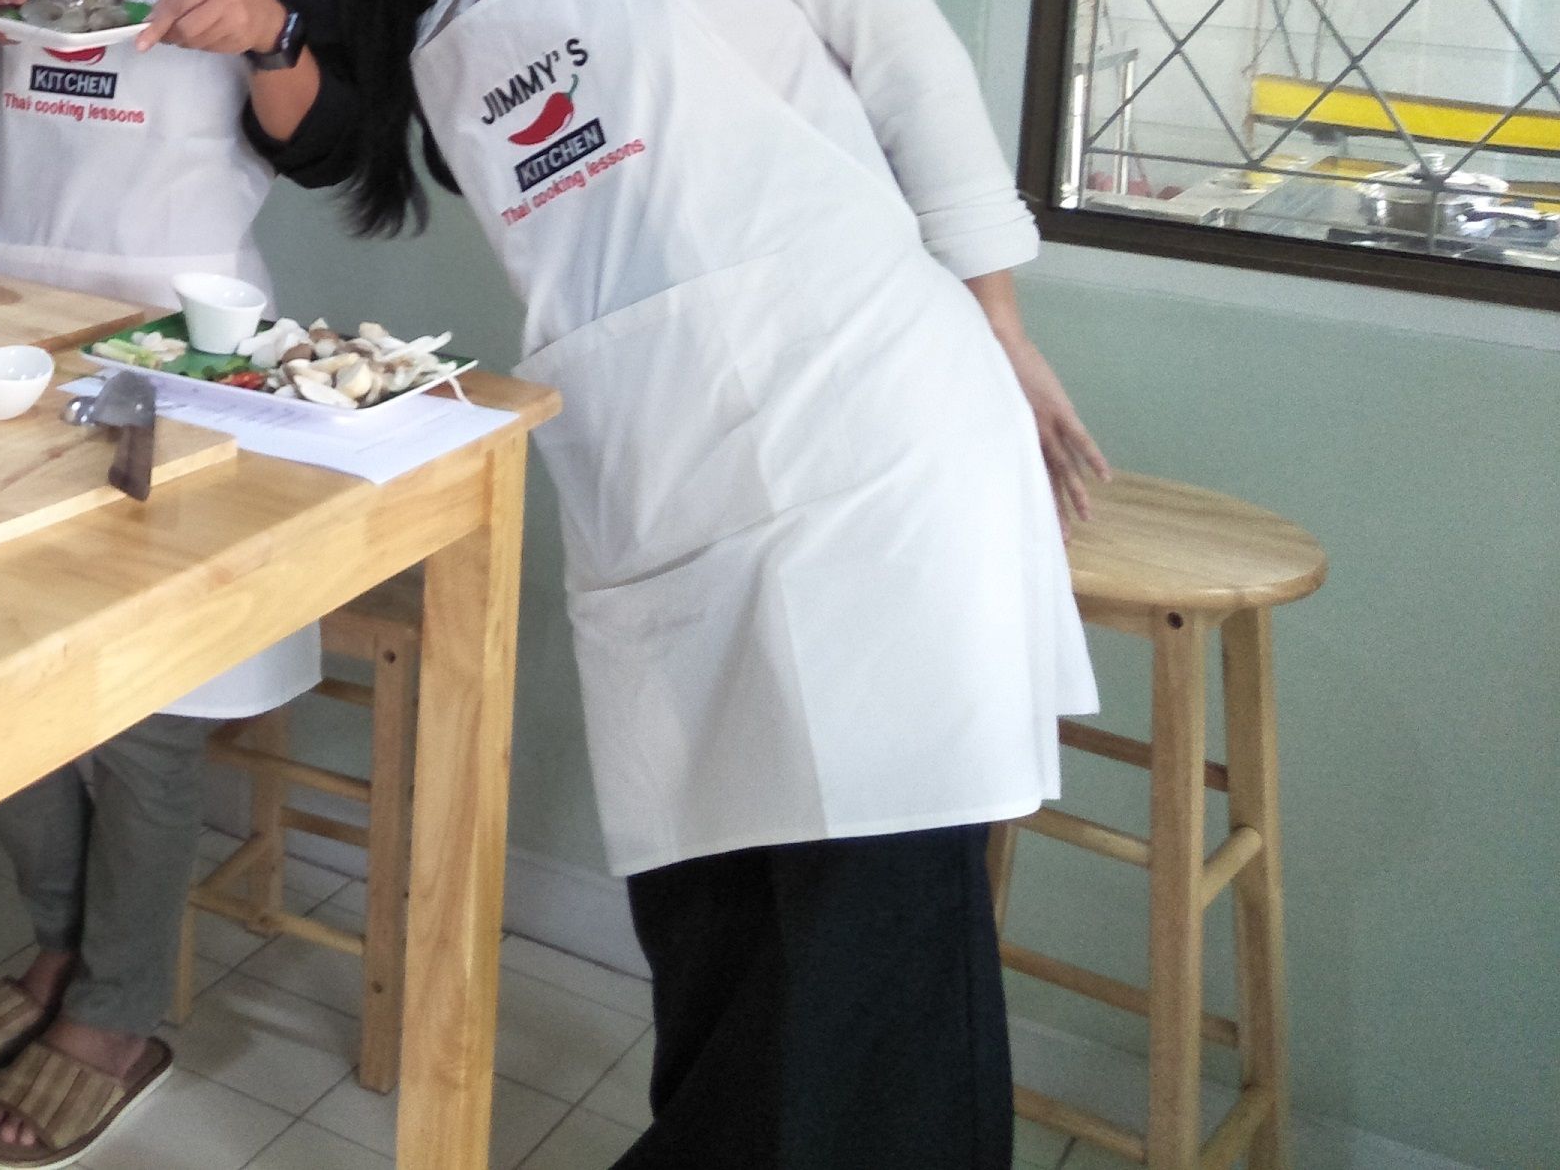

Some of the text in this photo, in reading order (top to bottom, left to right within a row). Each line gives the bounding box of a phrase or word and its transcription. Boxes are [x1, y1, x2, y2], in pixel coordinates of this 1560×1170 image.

[4, 93, 145, 124] Thai cooking lessons
[33, 68, 114, 96] KITCHEN
[481, 38, 589, 125] JIMMY'S
[501, 139, 646, 225] Thai cooking lessons
[520, 127, 601, 186] KITCHEN
